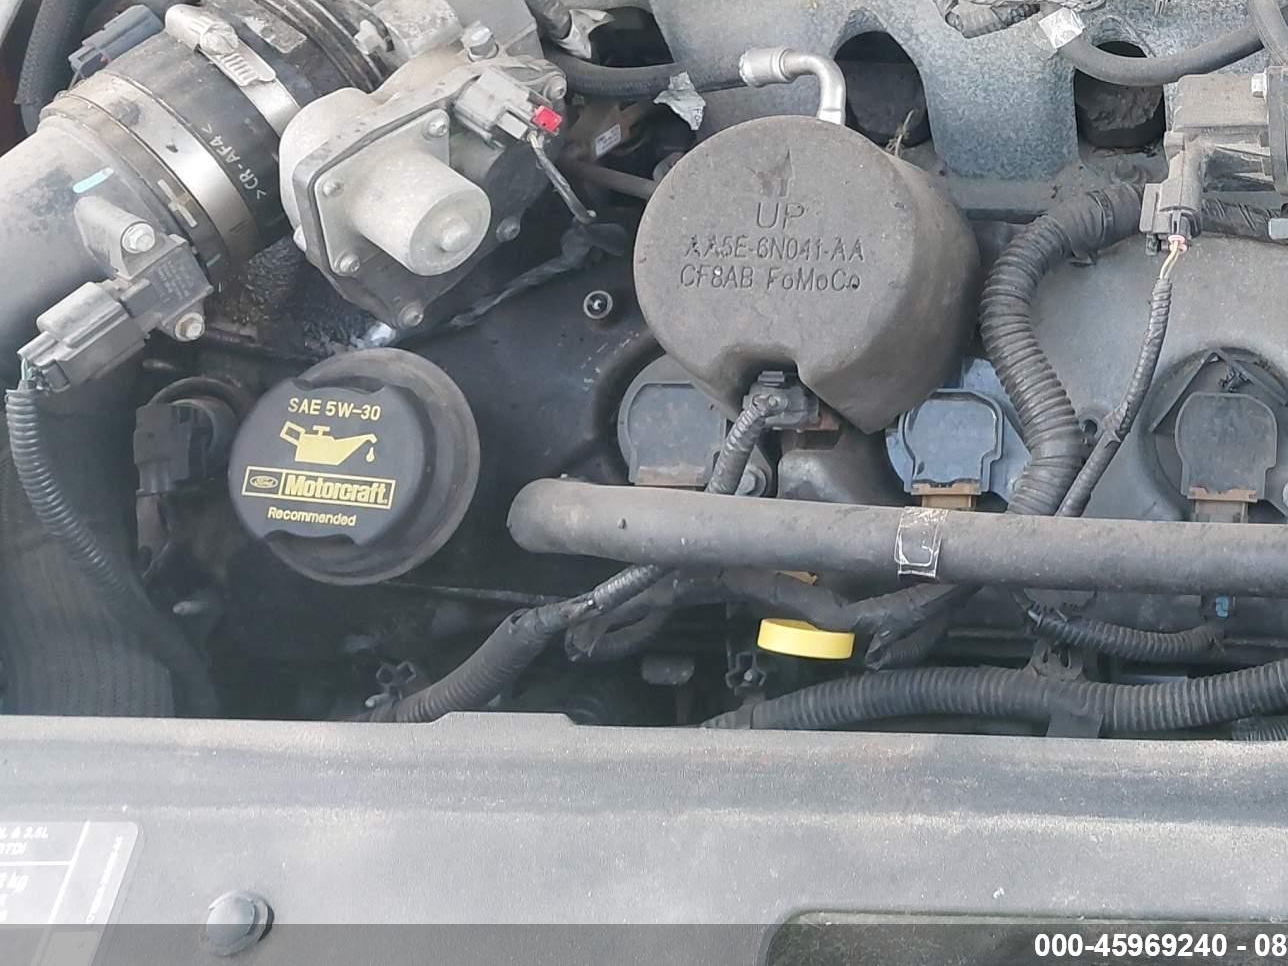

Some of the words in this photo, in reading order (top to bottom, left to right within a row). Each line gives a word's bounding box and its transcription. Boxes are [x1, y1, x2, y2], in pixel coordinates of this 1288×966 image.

[756, 201, 805, 231] UP
[680, 264, 753, 289] CF8AB
[767, 267, 861, 292] FoMoCo
[287, 397, 321, 415] SAE
[325, 400, 381, 421] 5W-30
[285, 474, 388, 505] Motorcraft
[267, 506, 357, 526] Recommended
